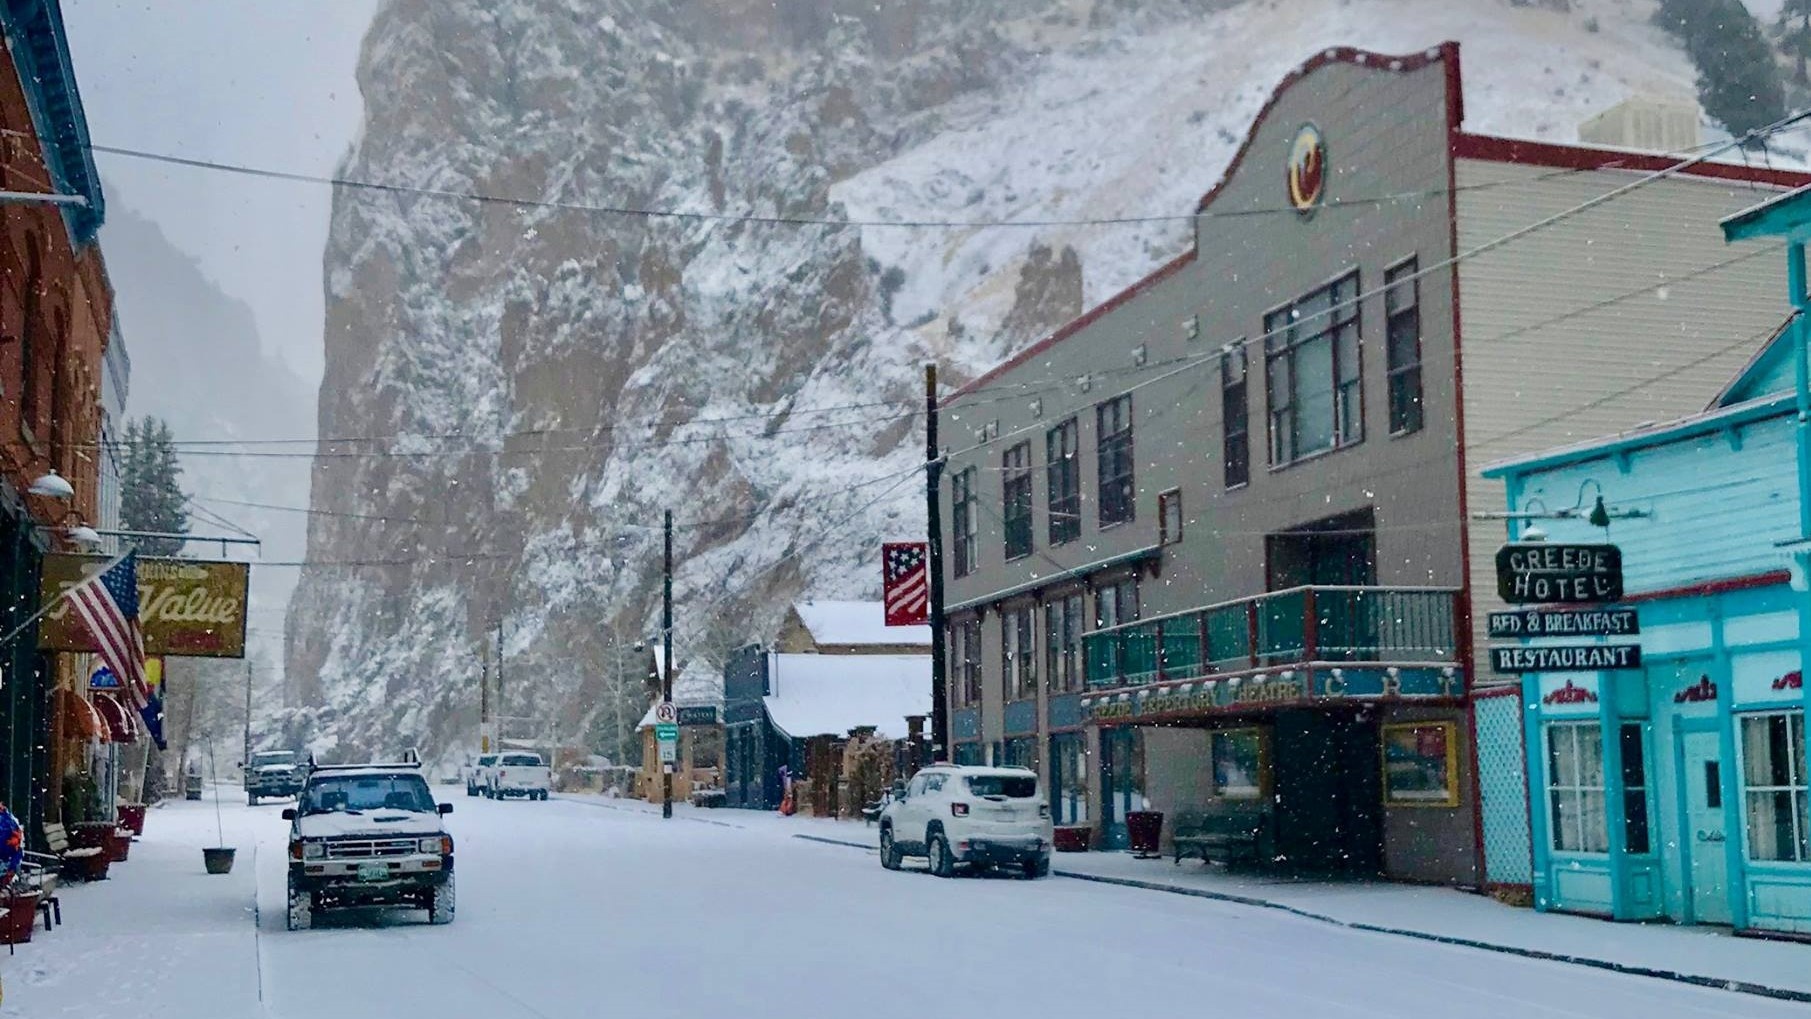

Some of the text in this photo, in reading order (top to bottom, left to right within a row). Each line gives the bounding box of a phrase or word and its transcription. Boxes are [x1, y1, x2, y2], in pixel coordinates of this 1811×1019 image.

[1510, 548, 1609, 573] CREEDE
[1514, 575, 1611, 600] HOTEL
[137, 585, 239, 624] Value
[1492, 611, 1633, 633] BED & BREAKFAST
[1500, 647, 1632, 669] RESTAURANT
[1229, 681, 1299, 704] THEATRE
